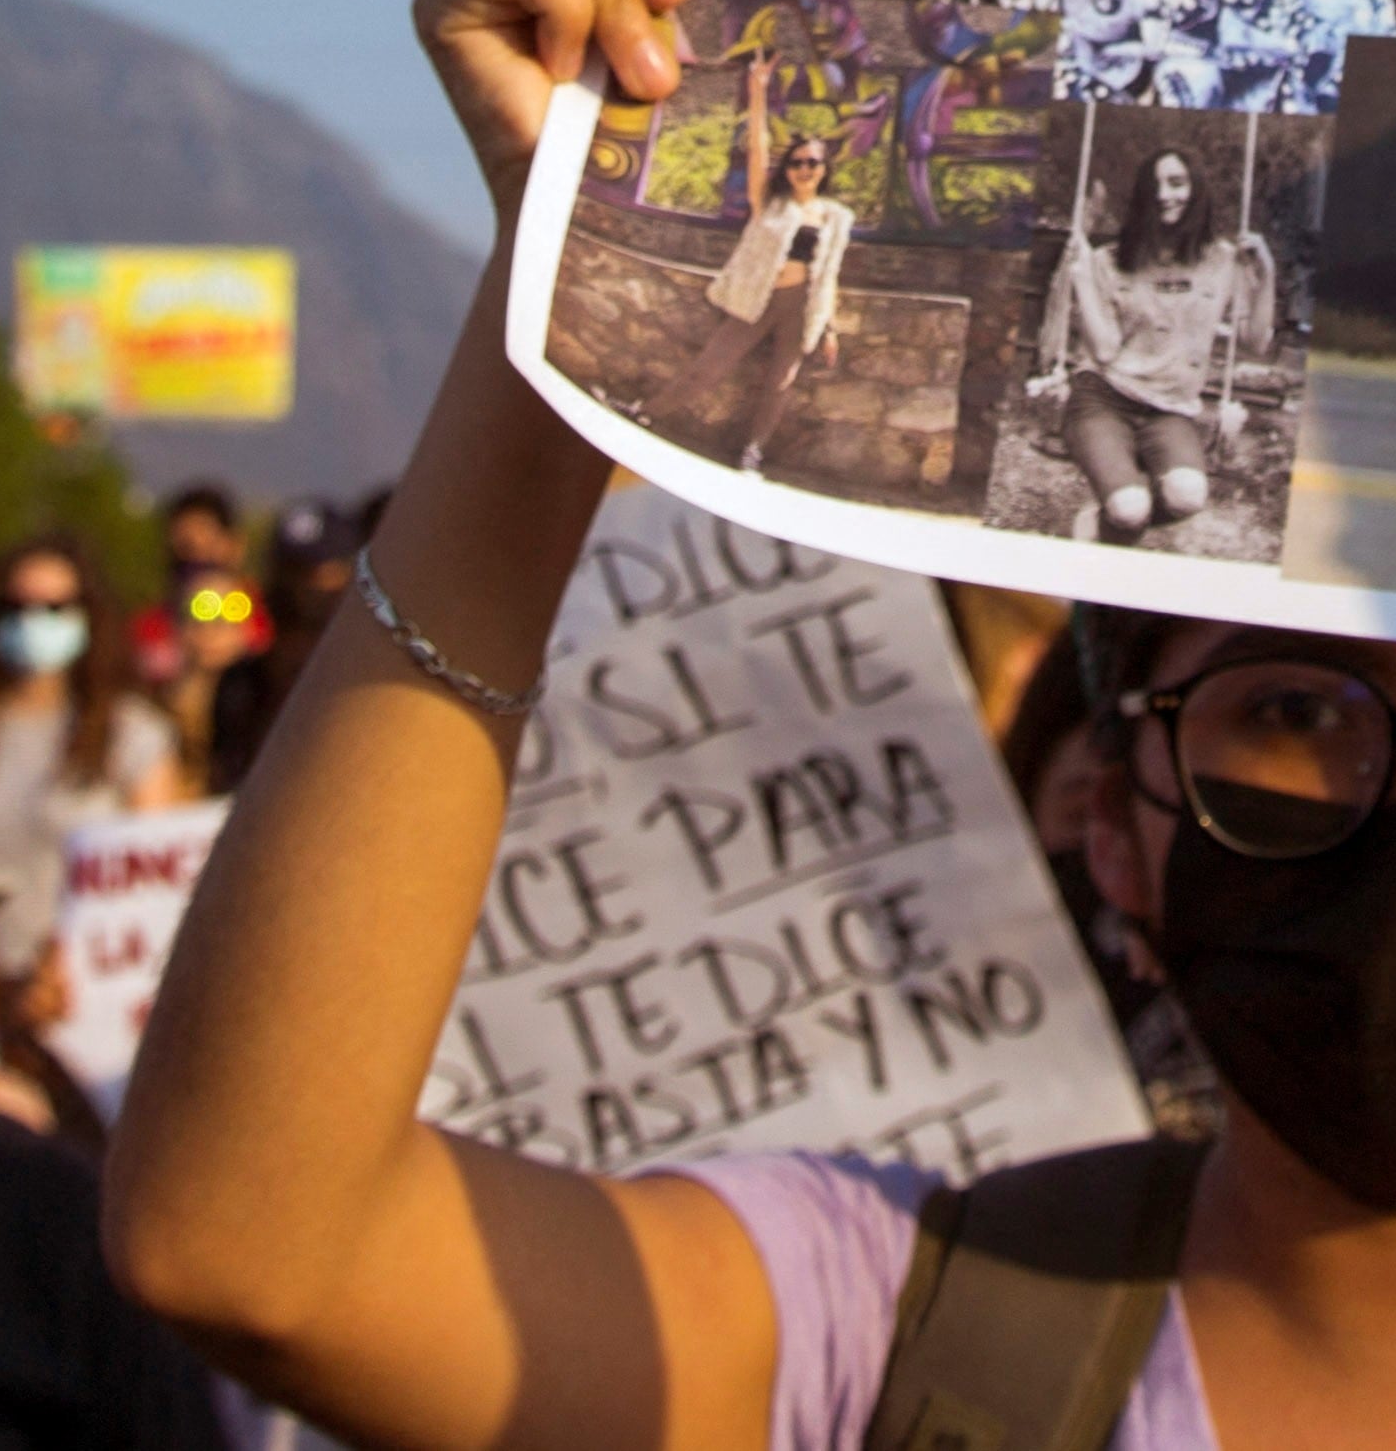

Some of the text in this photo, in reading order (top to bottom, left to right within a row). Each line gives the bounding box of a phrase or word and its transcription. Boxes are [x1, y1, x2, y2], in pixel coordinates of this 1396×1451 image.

[747, 584, 917, 716] TE
[638, 736, 955, 892] PARA
[541, 953, 683, 1076] TE
[673, 875, 948, 1031] DICE
[817, 990, 888, 1092] Y
[905, 958, 1046, 1074] NO
